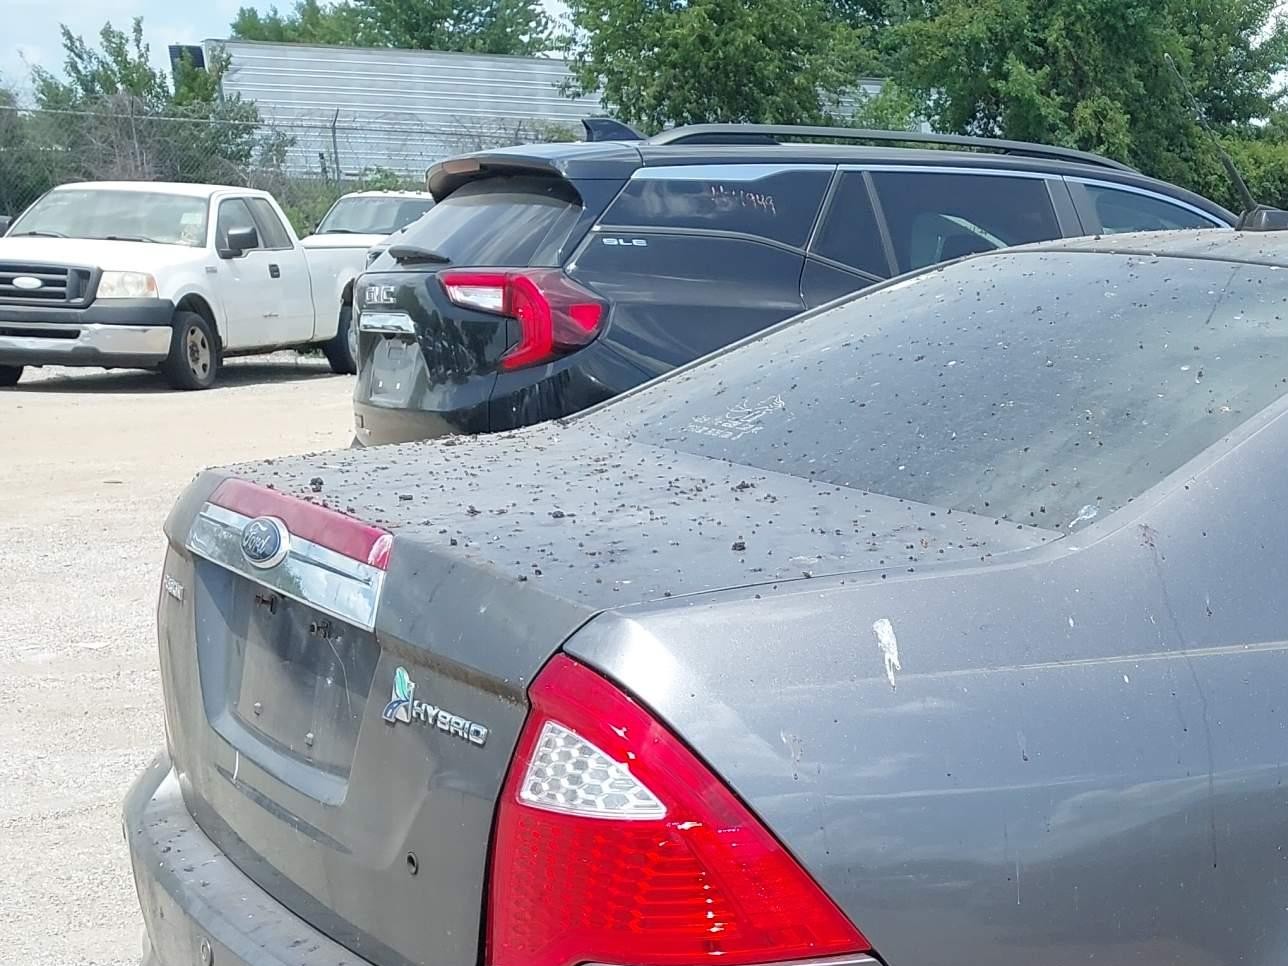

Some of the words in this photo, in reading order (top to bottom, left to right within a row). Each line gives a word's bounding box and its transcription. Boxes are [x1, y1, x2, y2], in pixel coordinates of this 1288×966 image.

[602, 238, 648, 247] SLE
[242, 521, 271, 555] Ford
[412, 700, 489, 745] HYBRID
